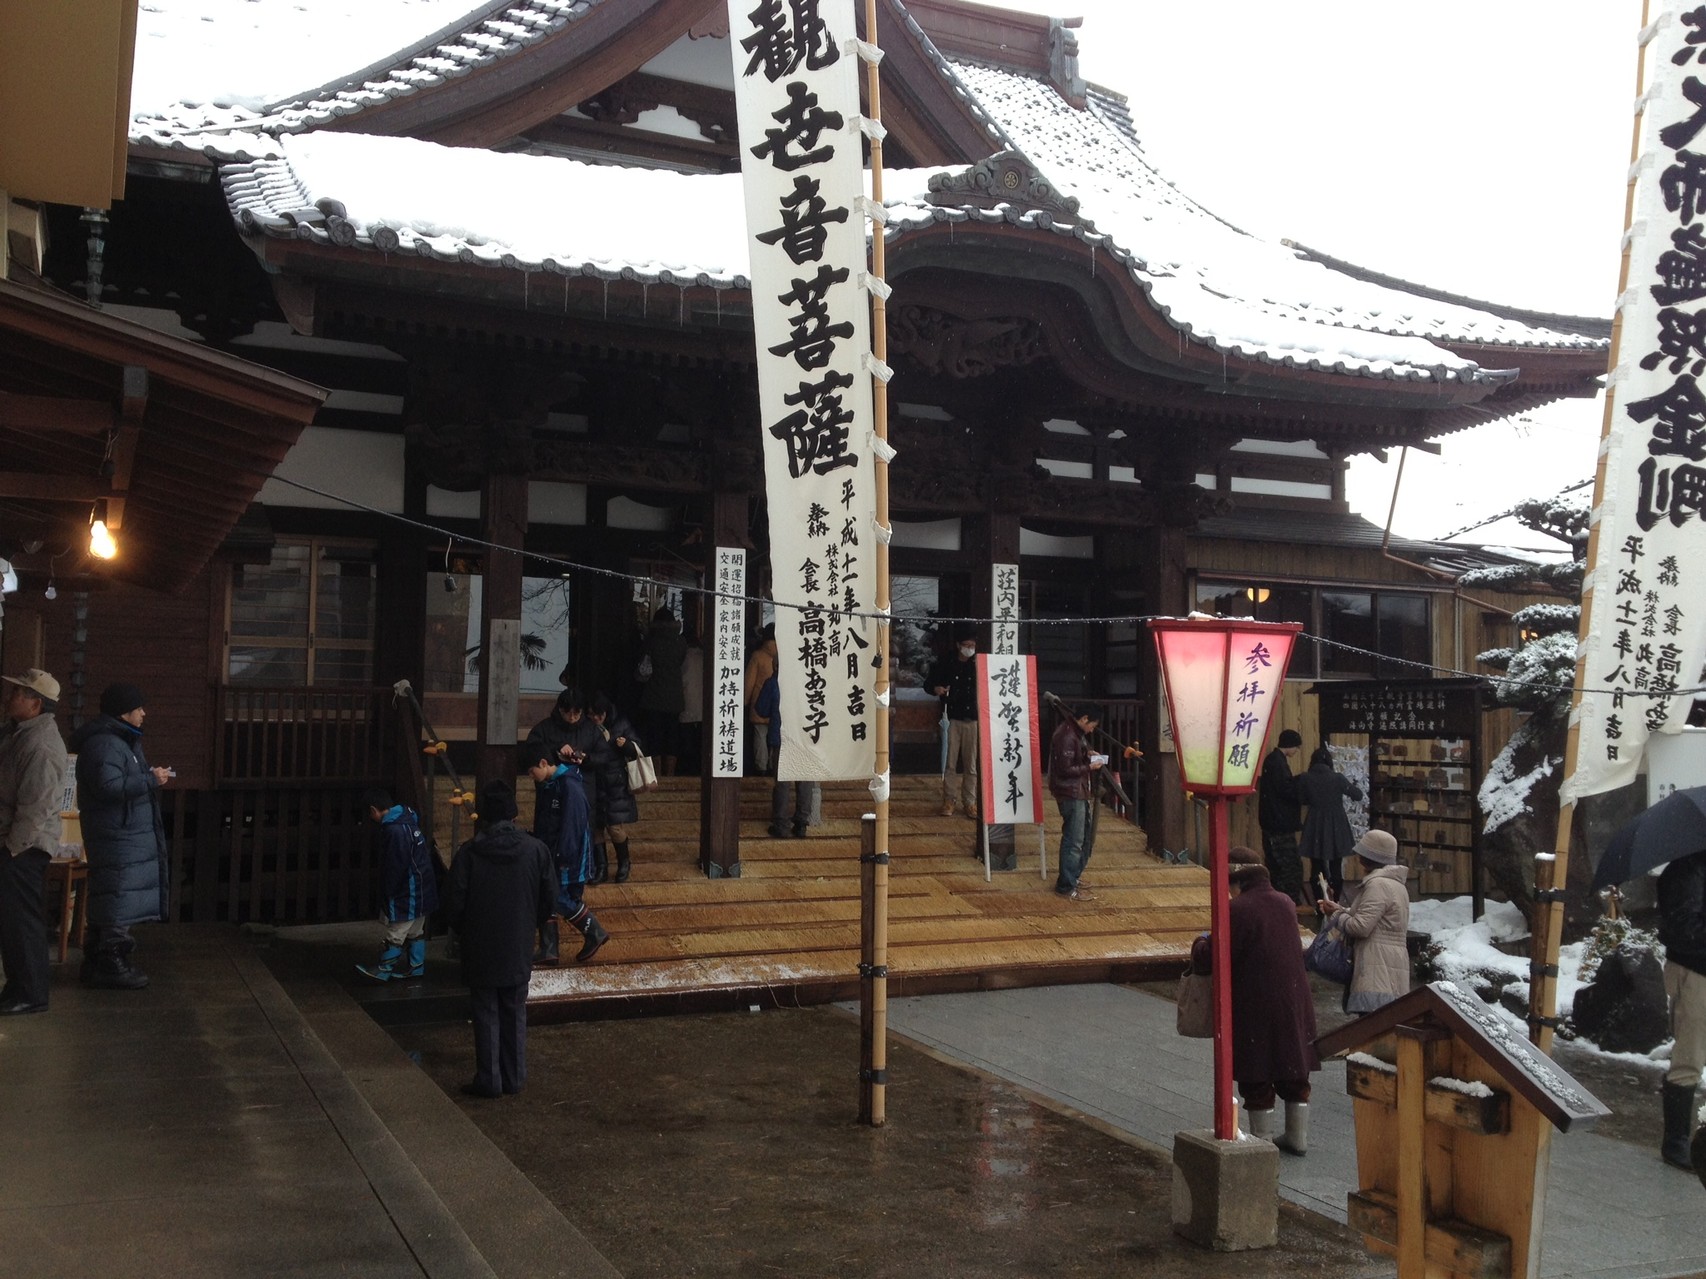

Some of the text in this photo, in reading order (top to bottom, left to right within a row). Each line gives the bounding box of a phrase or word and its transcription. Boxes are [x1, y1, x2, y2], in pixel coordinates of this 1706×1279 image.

[798, 503, 830, 744] 奉納 会長 高橋あき子
[825, 544, 840, 597] 株式会社
[840, 478, 869, 742] 平成十一年八月吉日
[991, 659, 1024, 815] 謹賀新年
[1227, 642, 1272, 769] 参拝祈願
